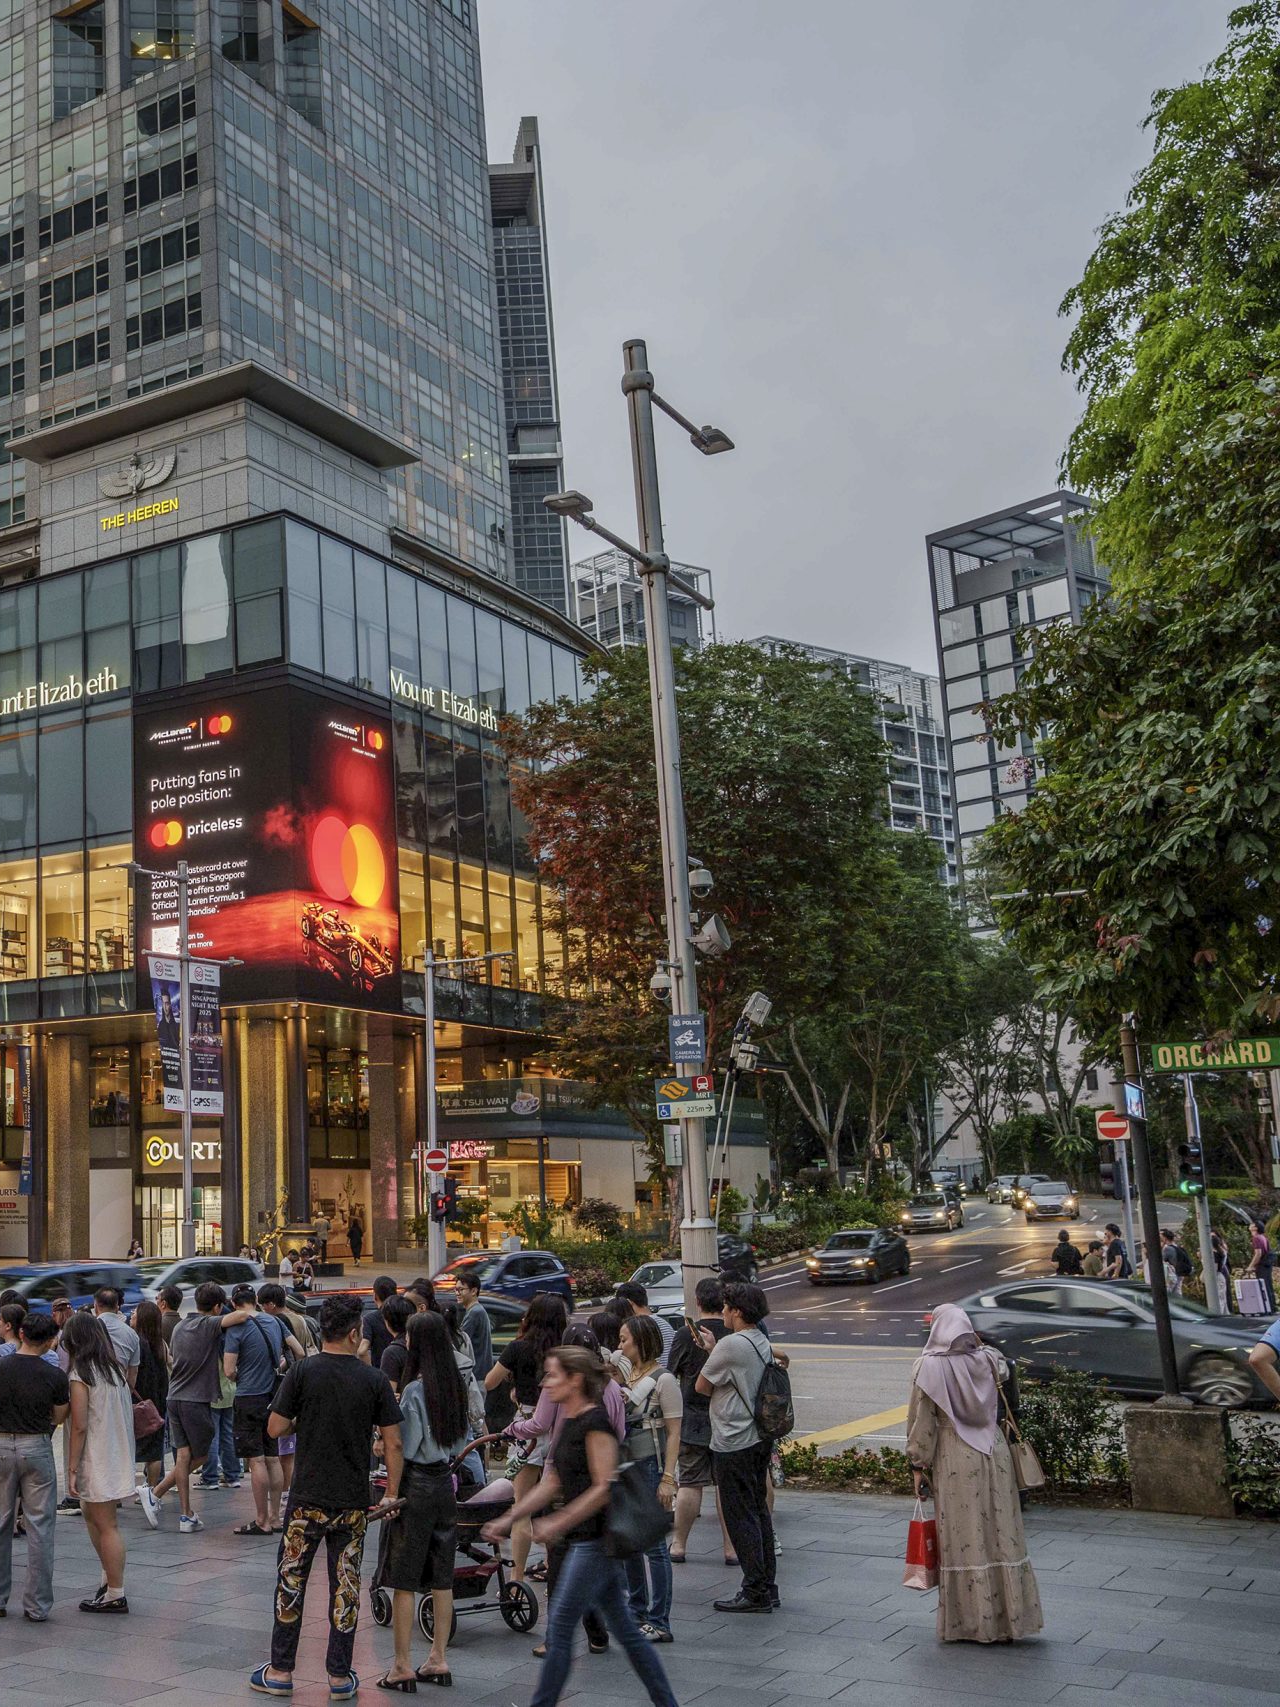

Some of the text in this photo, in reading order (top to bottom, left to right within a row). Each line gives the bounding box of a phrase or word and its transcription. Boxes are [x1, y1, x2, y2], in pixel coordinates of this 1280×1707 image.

[100, 497, 179, 530] THE HEEREN
[26, 667, 119, 709] Elizabeth
[390, 669, 498, 732] Mount Elizabeth
[151, 765, 240, 792] Putting fans in
[151, 787, 232, 813] pole position:
[187, 817, 243, 838] priceless
[186, 862, 221, 874] astercard
[232, 860, 248, 869] over
[151, 880, 169, 890] 2000
[201, 875, 208, 883] in
[209, 871, 245, 882] Singapore
[151, 892, 162, 900] for
[193, 886, 214, 895] offers
[215, 883, 229, 892] and
[151, 900, 177, 910] Official
[209, 892, 239, 903] Formula
[240, 891, 245, 900] 1
[151, 911, 171, 921] Team
[197, 940, 213, 948] more
[192, 995, 218, 1004] SINGAPORE
[1158, 1041, 1272, 1069] ORCHARD
[463, 1097, 509, 1107] TSUI WAH
[686, 1103, 705, 1113] 225m
